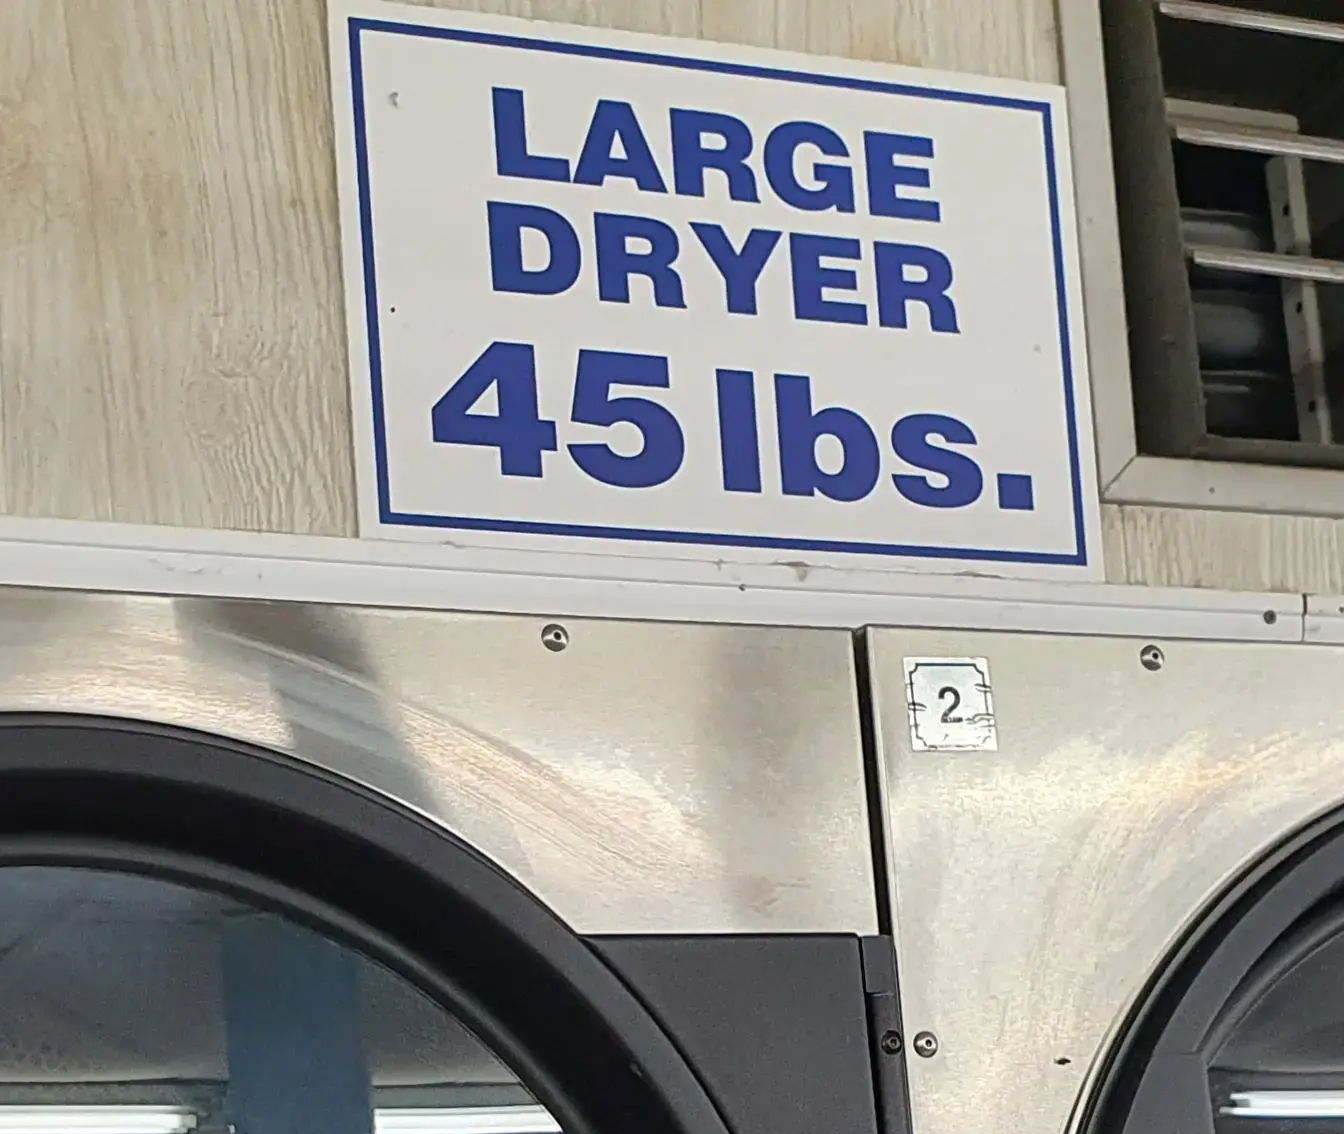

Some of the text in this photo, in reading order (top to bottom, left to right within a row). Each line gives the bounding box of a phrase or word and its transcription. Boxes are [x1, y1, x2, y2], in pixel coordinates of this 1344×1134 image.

[492, 87, 941, 222] LARGE
[488, 201, 958, 332] DRYER
[433, 341, 1033, 509] 45 lbs.
[938, 686, 963, 723] 2
